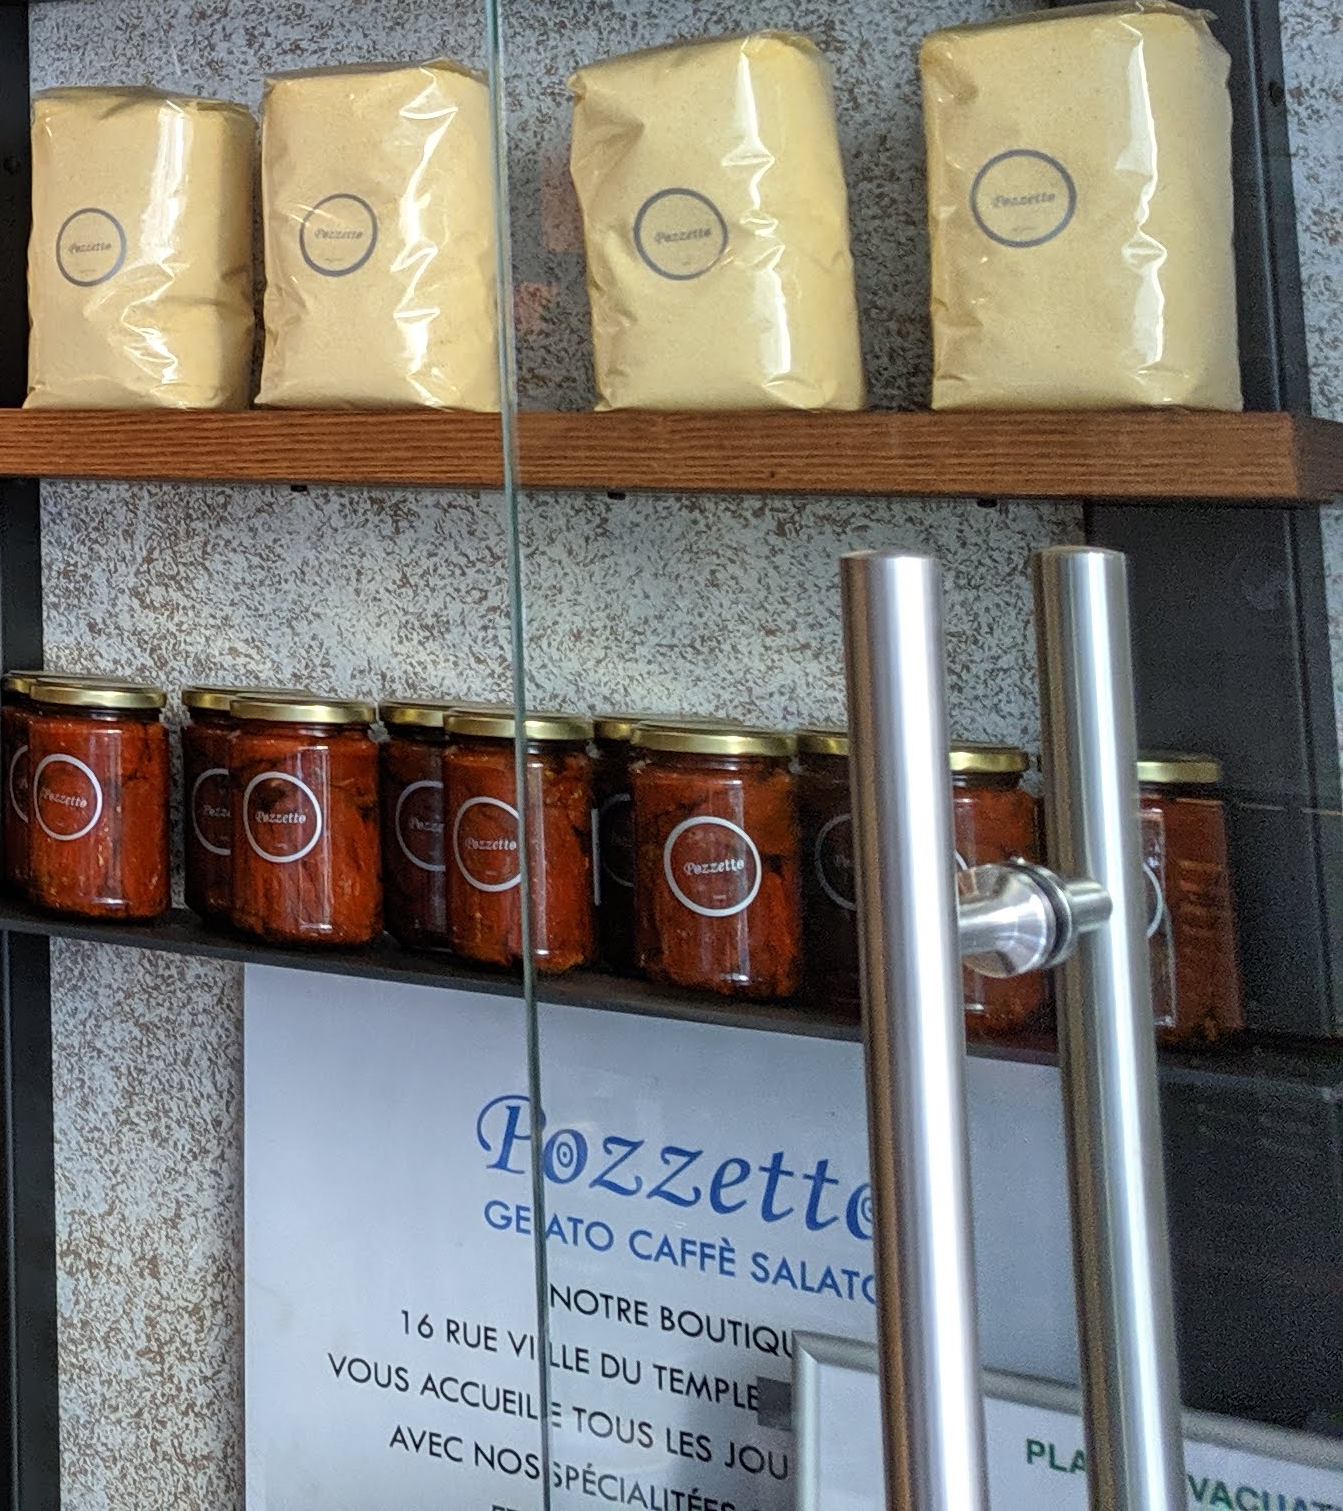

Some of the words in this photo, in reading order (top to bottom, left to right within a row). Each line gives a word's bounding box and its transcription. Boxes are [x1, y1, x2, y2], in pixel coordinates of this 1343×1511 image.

[992, 190, 1058, 209] Pozzetto
[314, 228, 363, 241] Pozzetto
[654, 227, 713, 245] Pozzetto
[68, 241, 112, 255] Pozzetto
[41, 790, 88, 809] Pozzetto
[255, 811, 307, 824] Pozzetto
[465, 839, 517, 851] Pozzetto
[684, 858, 745, 875] Pozzetto
[484, 1200, 613, 1252] GEATO
[628, 1229, 736, 1277] CAFFÈ
[549, 1284, 649, 1328] NOTRE
[660, 1305, 795, 1360] BOUTIQU
[401, 1310, 434, 1340] 16
[446, 1318, 498, 1352] RUE
[600, 1355, 641, 1385] DU
[652, 1364, 760, 1413] TEMPLE
[328, 1353, 409, 1392] VOUS
[420, 1374, 562, 1430] ACCUEILE
[572, 1406, 654, 1450] TOUS
[666, 1427, 713, 1464] LES
[724, 1435, 790, 1482] JOU
[389, 1424, 463, 1463] AVEC
[474, 1443, 541, 1481] NOS
[1025, 1438, 1088, 1475] PLA
